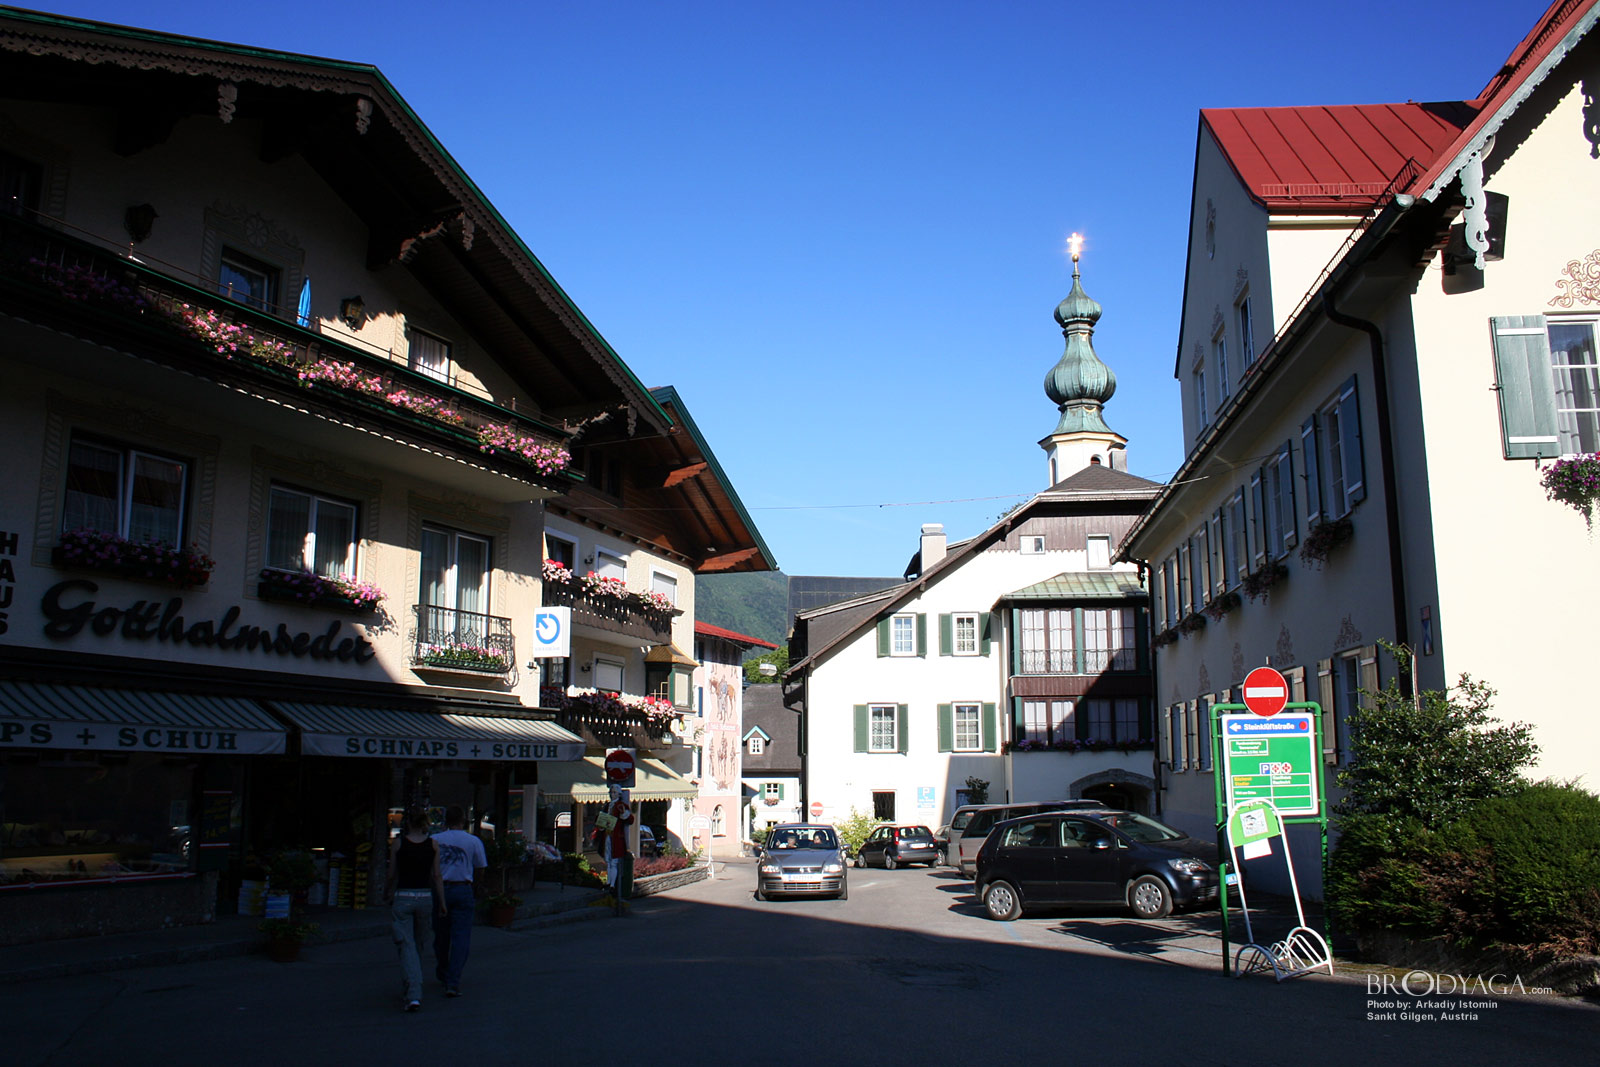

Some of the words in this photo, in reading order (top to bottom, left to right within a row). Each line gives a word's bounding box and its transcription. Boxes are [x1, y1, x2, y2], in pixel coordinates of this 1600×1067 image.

[41, 579, 376, 663] Gotthalmseder
[118, 727, 238, 750] SCHUH
[346, 737, 459, 757] SCHNAPS
[492, 744, 558, 758] SCHUH
